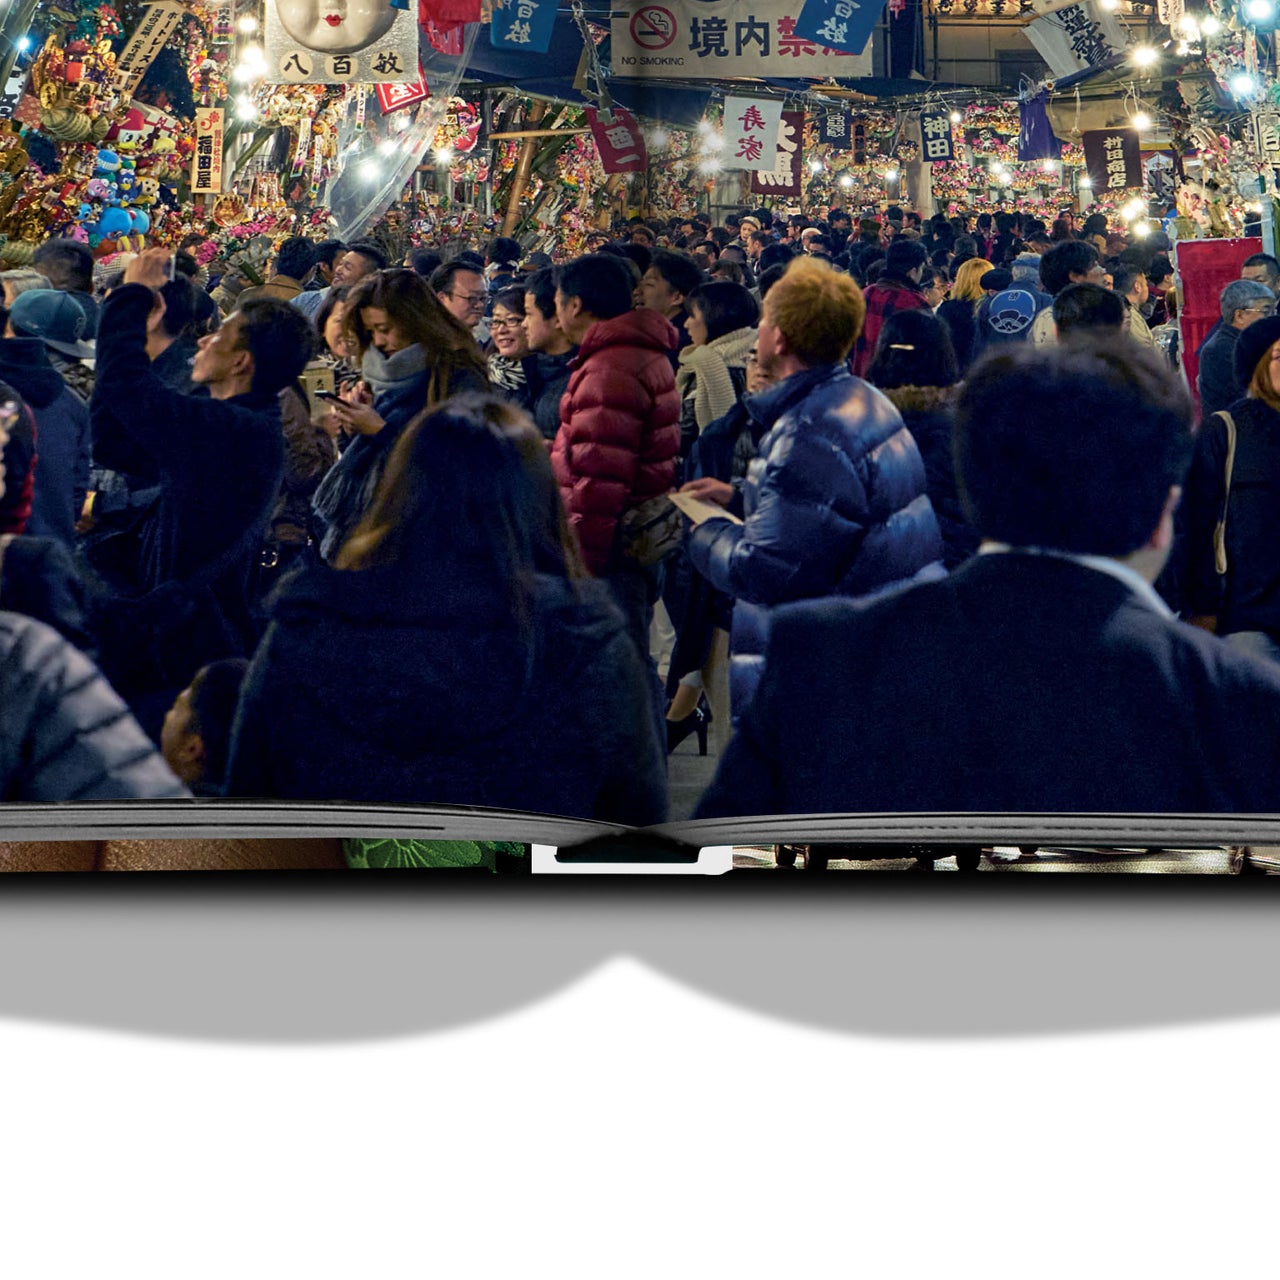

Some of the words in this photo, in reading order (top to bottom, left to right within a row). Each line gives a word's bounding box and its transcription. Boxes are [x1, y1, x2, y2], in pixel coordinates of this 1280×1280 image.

[689, 15, 858, 58] 境内禁
[621, 56, 637, 66] NO
[639, 56, 685, 66] SMOKING
[923, 116, 950, 158] 神田
[1103, 136, 1127, 188] 村田商店
